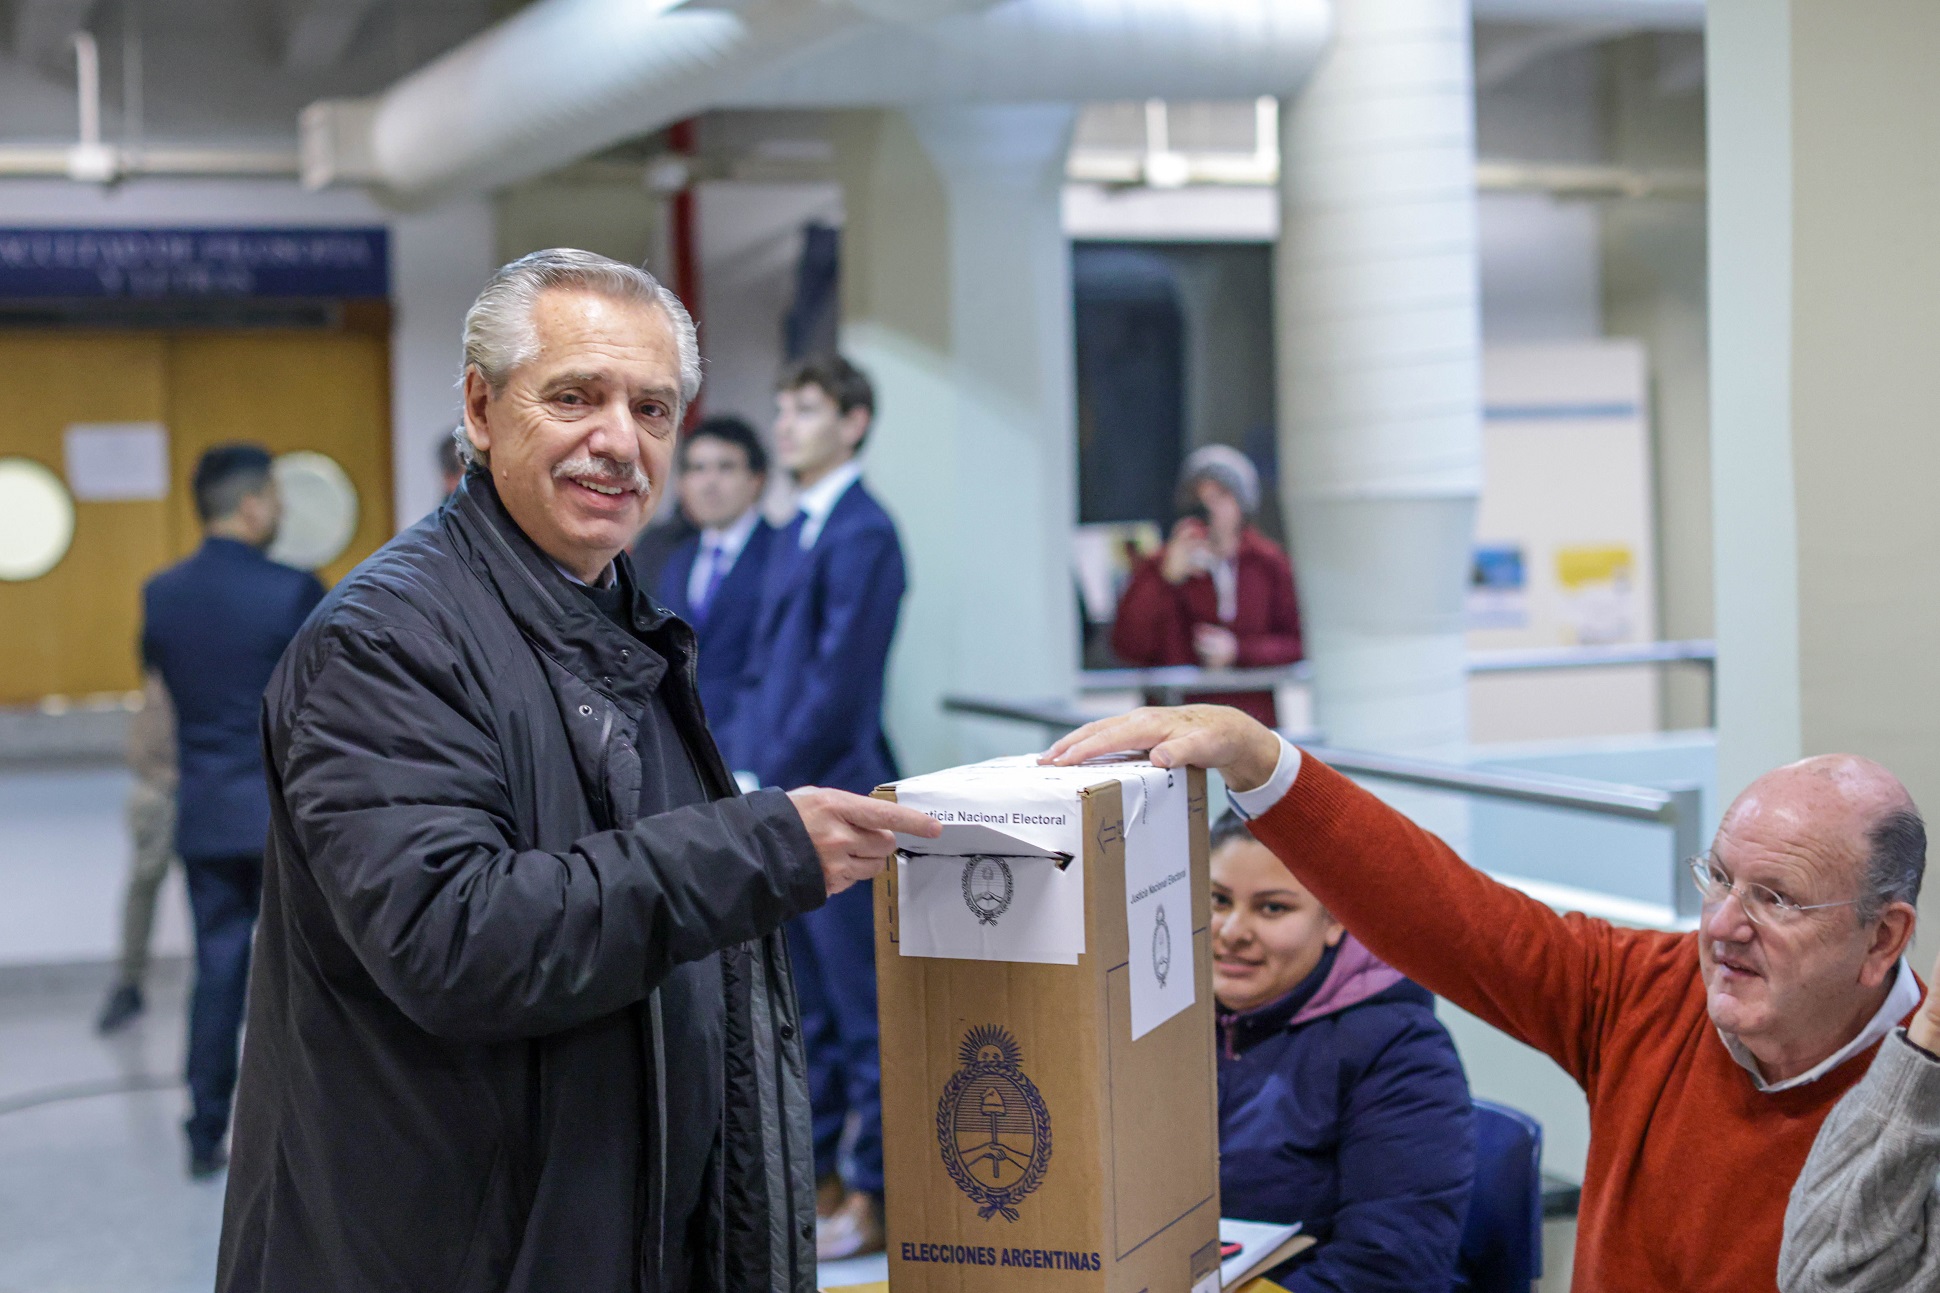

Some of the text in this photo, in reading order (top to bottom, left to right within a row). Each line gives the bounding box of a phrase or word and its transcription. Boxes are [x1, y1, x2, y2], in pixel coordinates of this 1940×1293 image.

[924, 810, 1067, 826] ticia Nacional Electoral
[901, 1242, 1101, 1271] ELECCIONES ARGENTINAS
